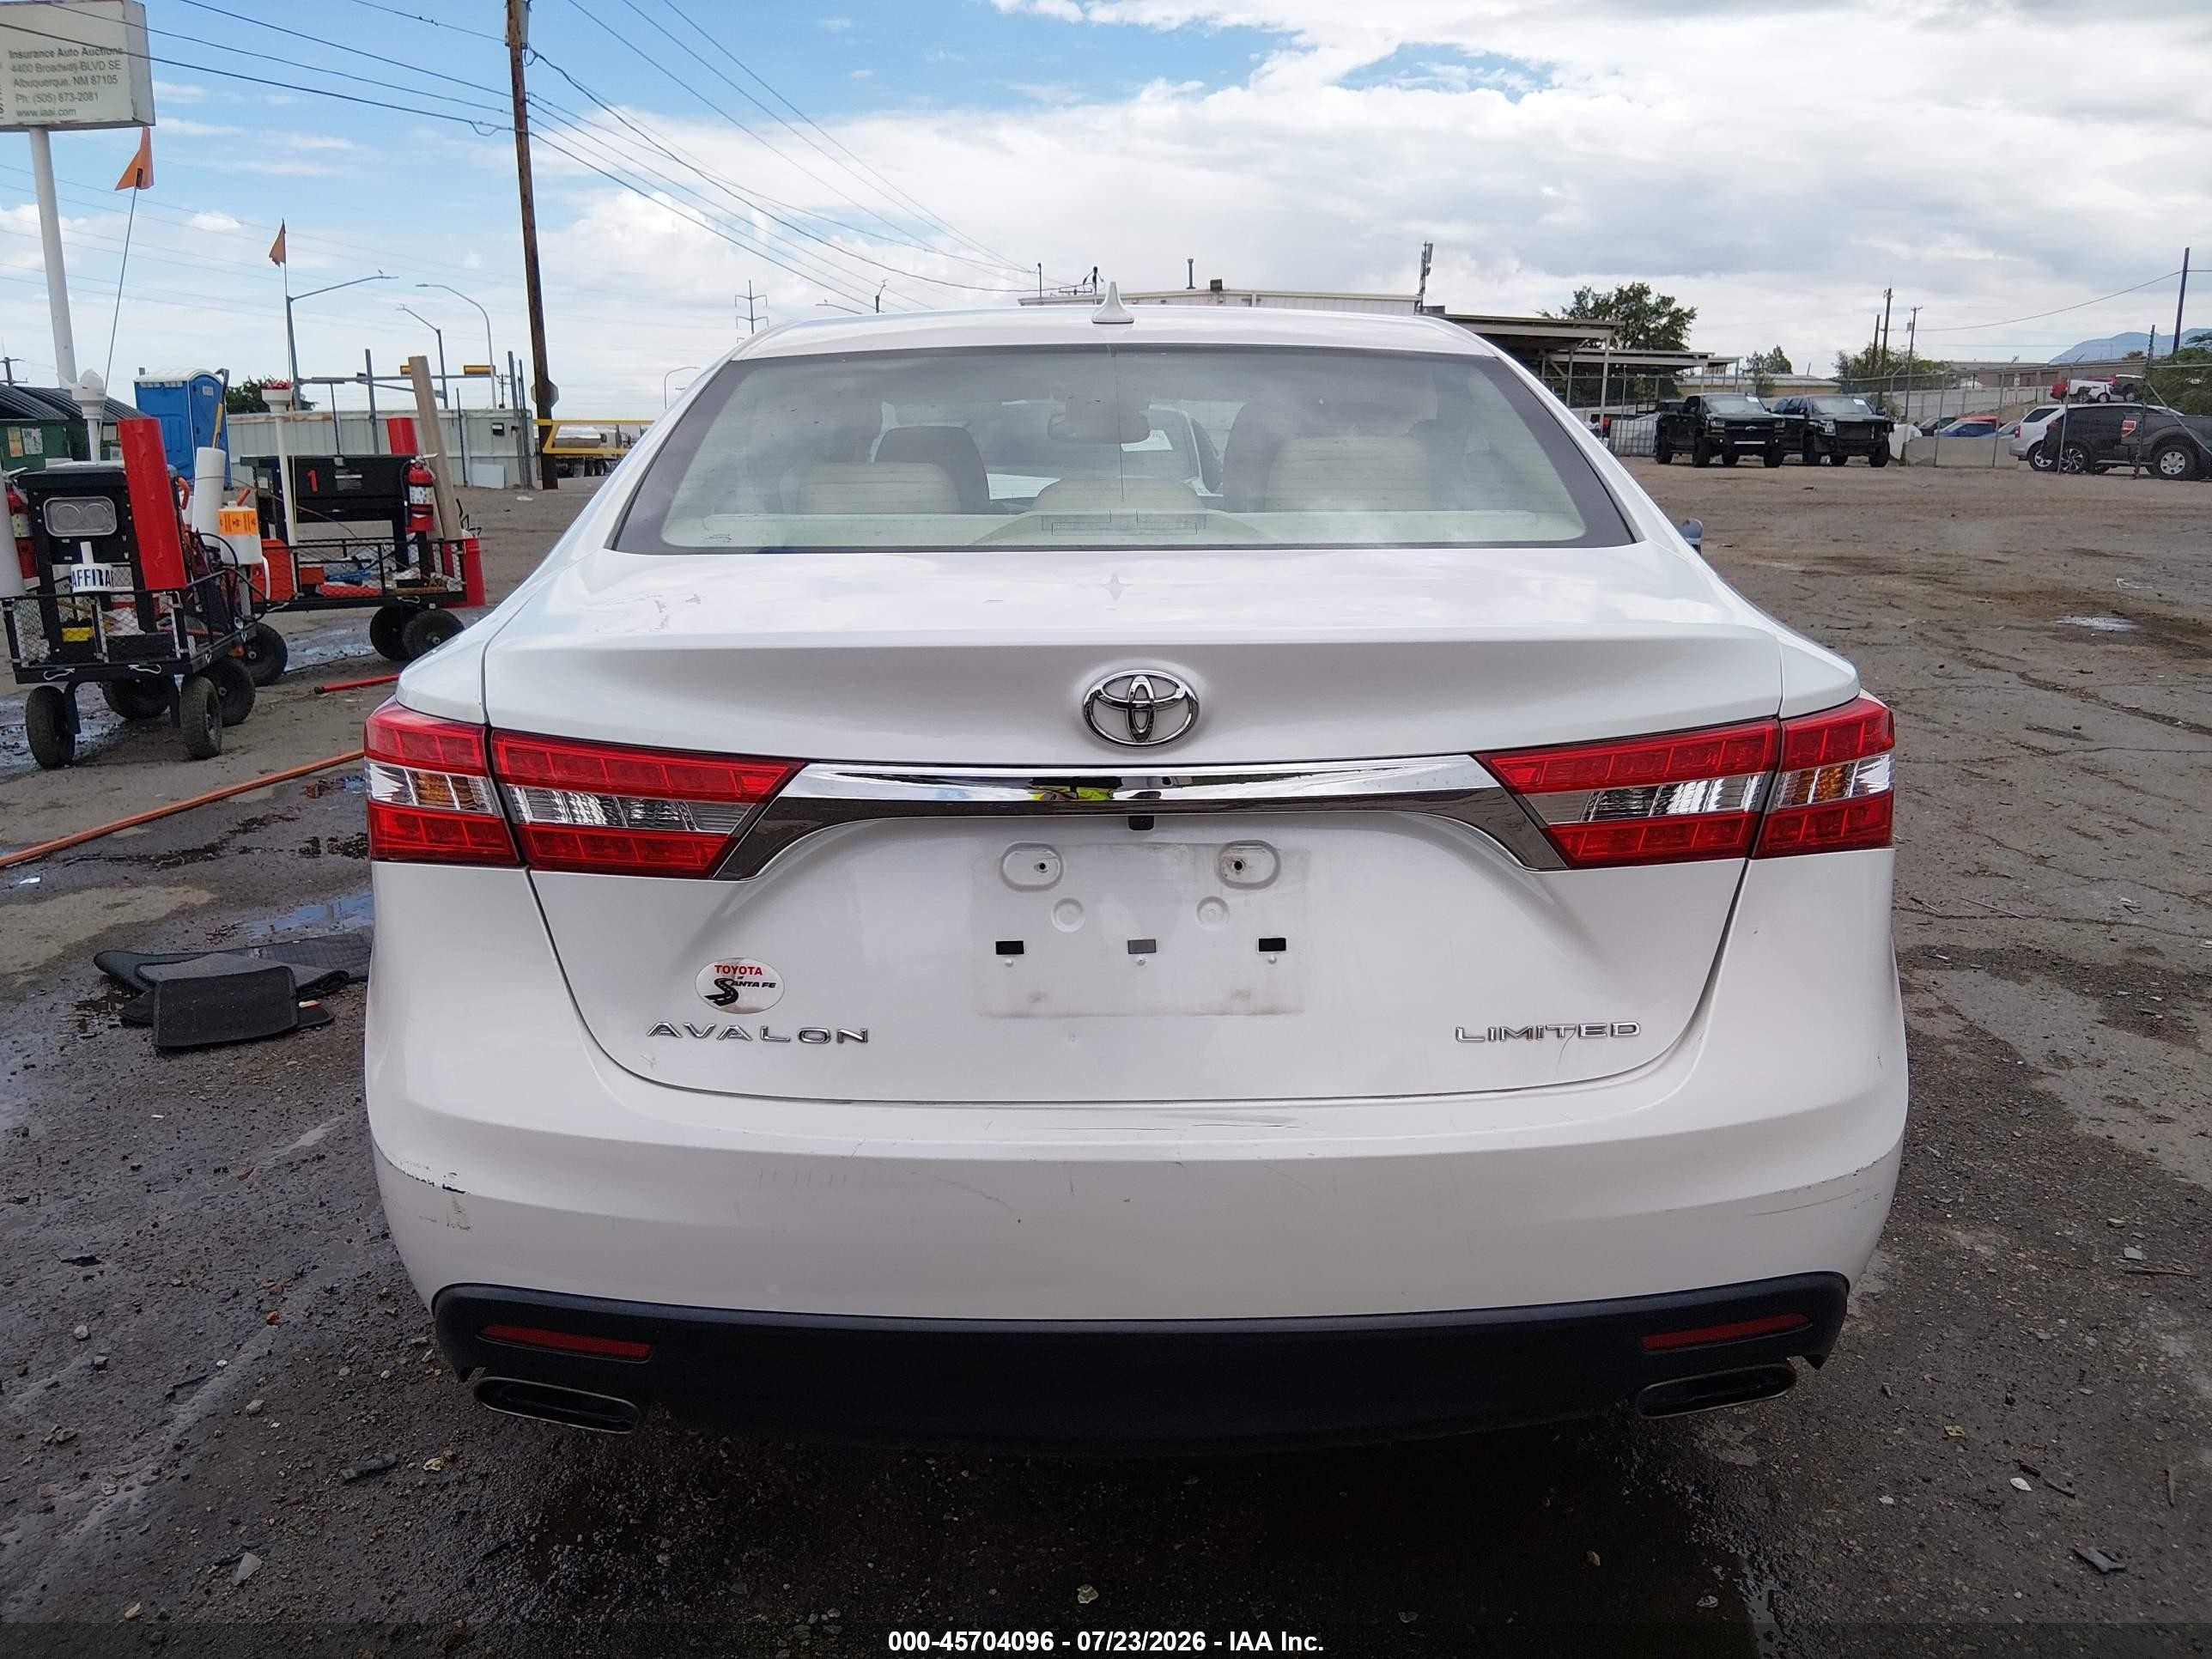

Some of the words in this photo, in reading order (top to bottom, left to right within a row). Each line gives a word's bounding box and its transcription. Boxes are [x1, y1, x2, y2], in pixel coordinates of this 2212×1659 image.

[9, 49, 55, 59] Insurance
[57, 47, 79, 57] Auto
[82, 46, 124, 57] Auctions
[11, 63, 34, 73] 4400
[35, 62, 79, 74] Broadway
[81, 61, 106, 71] BLVD
[108, 60, 122, 70] SE
[73, 76, 88, 85] NM
[90, 74, 118, 84] 87105
[33, 93, 57, 105] (505)
[58, 92, 99, 102] 873-2081
[307, 469, 319, 492] 1
[714, 964, 763, 975] TOYOTA
[647, 1021, 869, 1044] AVALON
[1455, 1021, 1641, 1042] LIMITED
